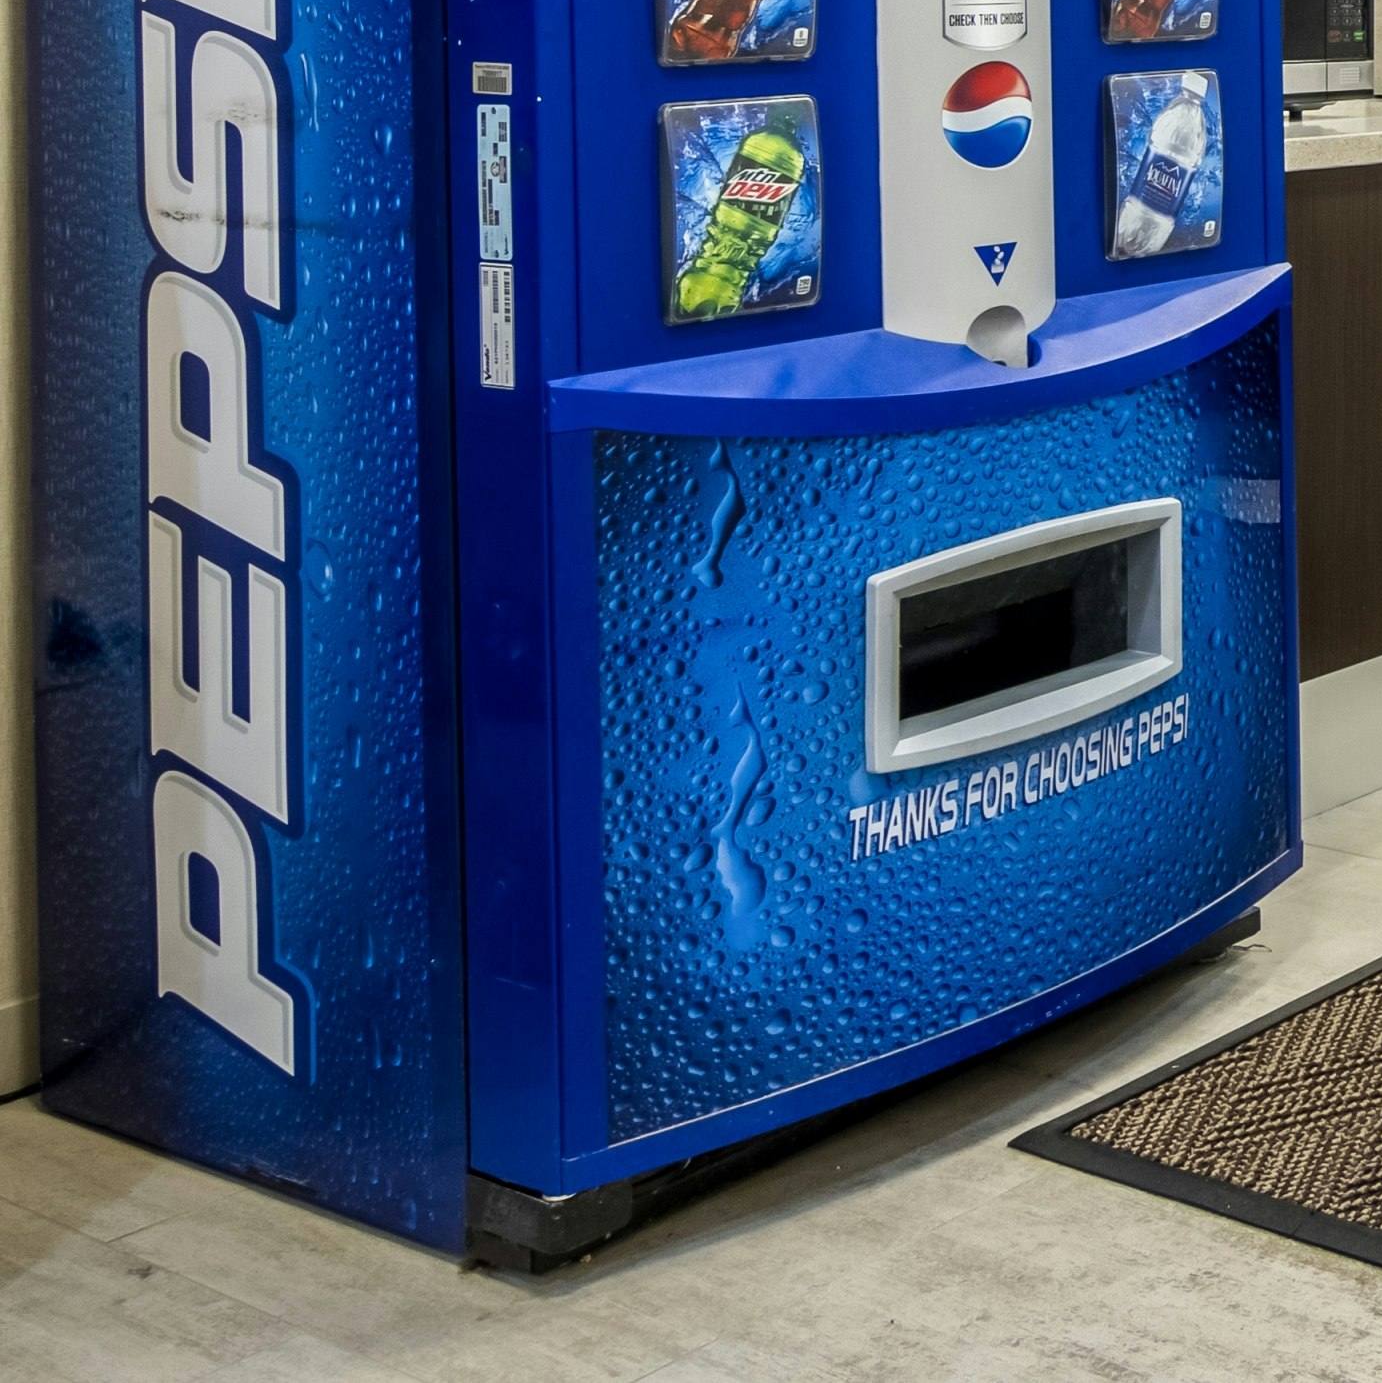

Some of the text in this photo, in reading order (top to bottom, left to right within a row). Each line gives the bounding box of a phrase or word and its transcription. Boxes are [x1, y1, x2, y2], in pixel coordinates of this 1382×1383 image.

[949, 12, 1024, 27] CHECK THEN CHOOSE
[735, 169, 776, 183] Mtn
[724, 183, 789, 201] Dew
[849, 692, 1190, 861] THANKS FOR CHOOSING PEPSI
